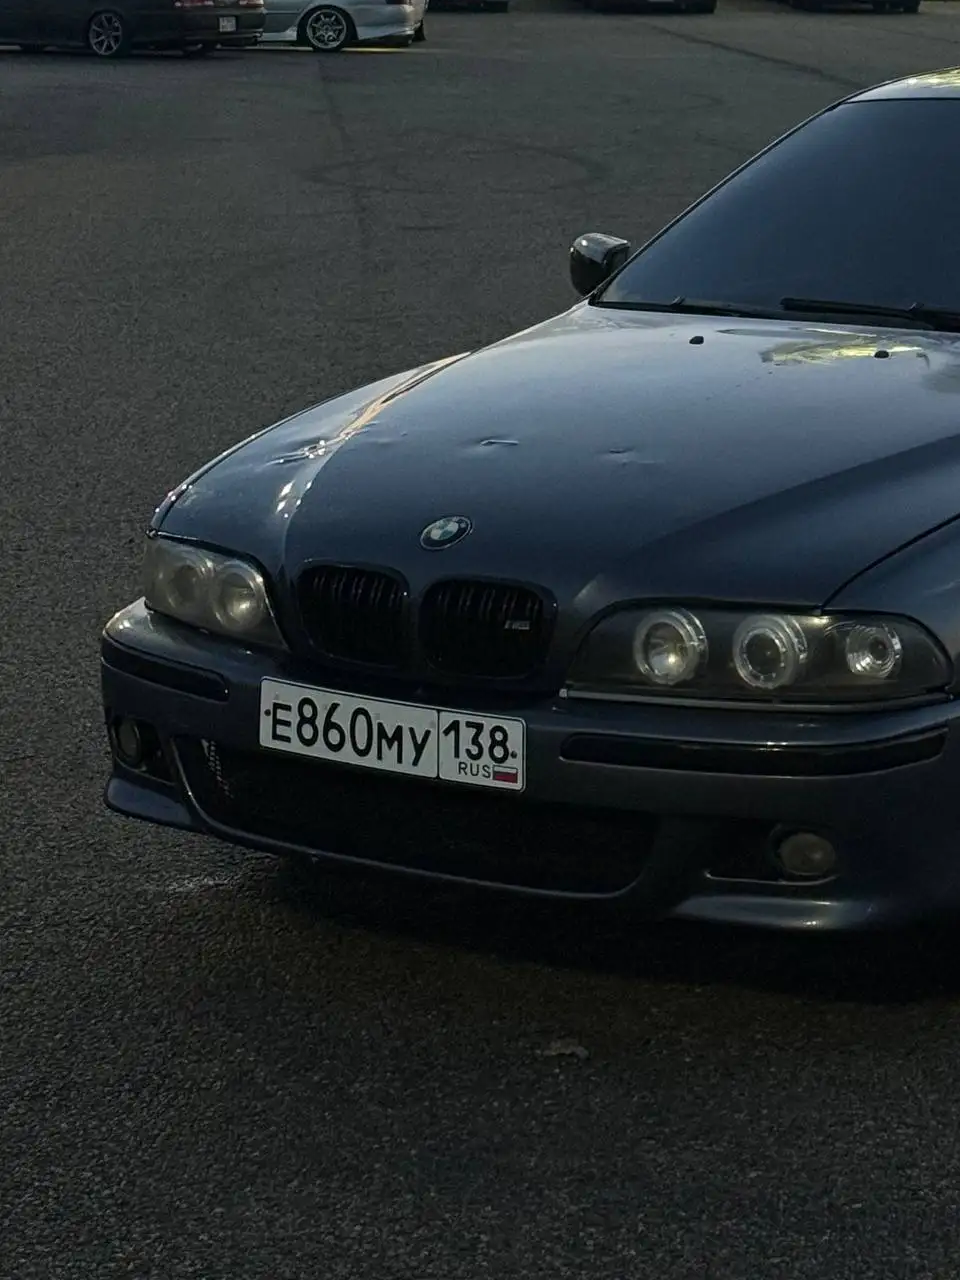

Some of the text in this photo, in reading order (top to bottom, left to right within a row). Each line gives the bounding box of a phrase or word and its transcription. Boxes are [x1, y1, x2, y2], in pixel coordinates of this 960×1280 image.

[271, 697, 509, 767] Е860МУ 138
[457, 761, 491, 780] RUS
